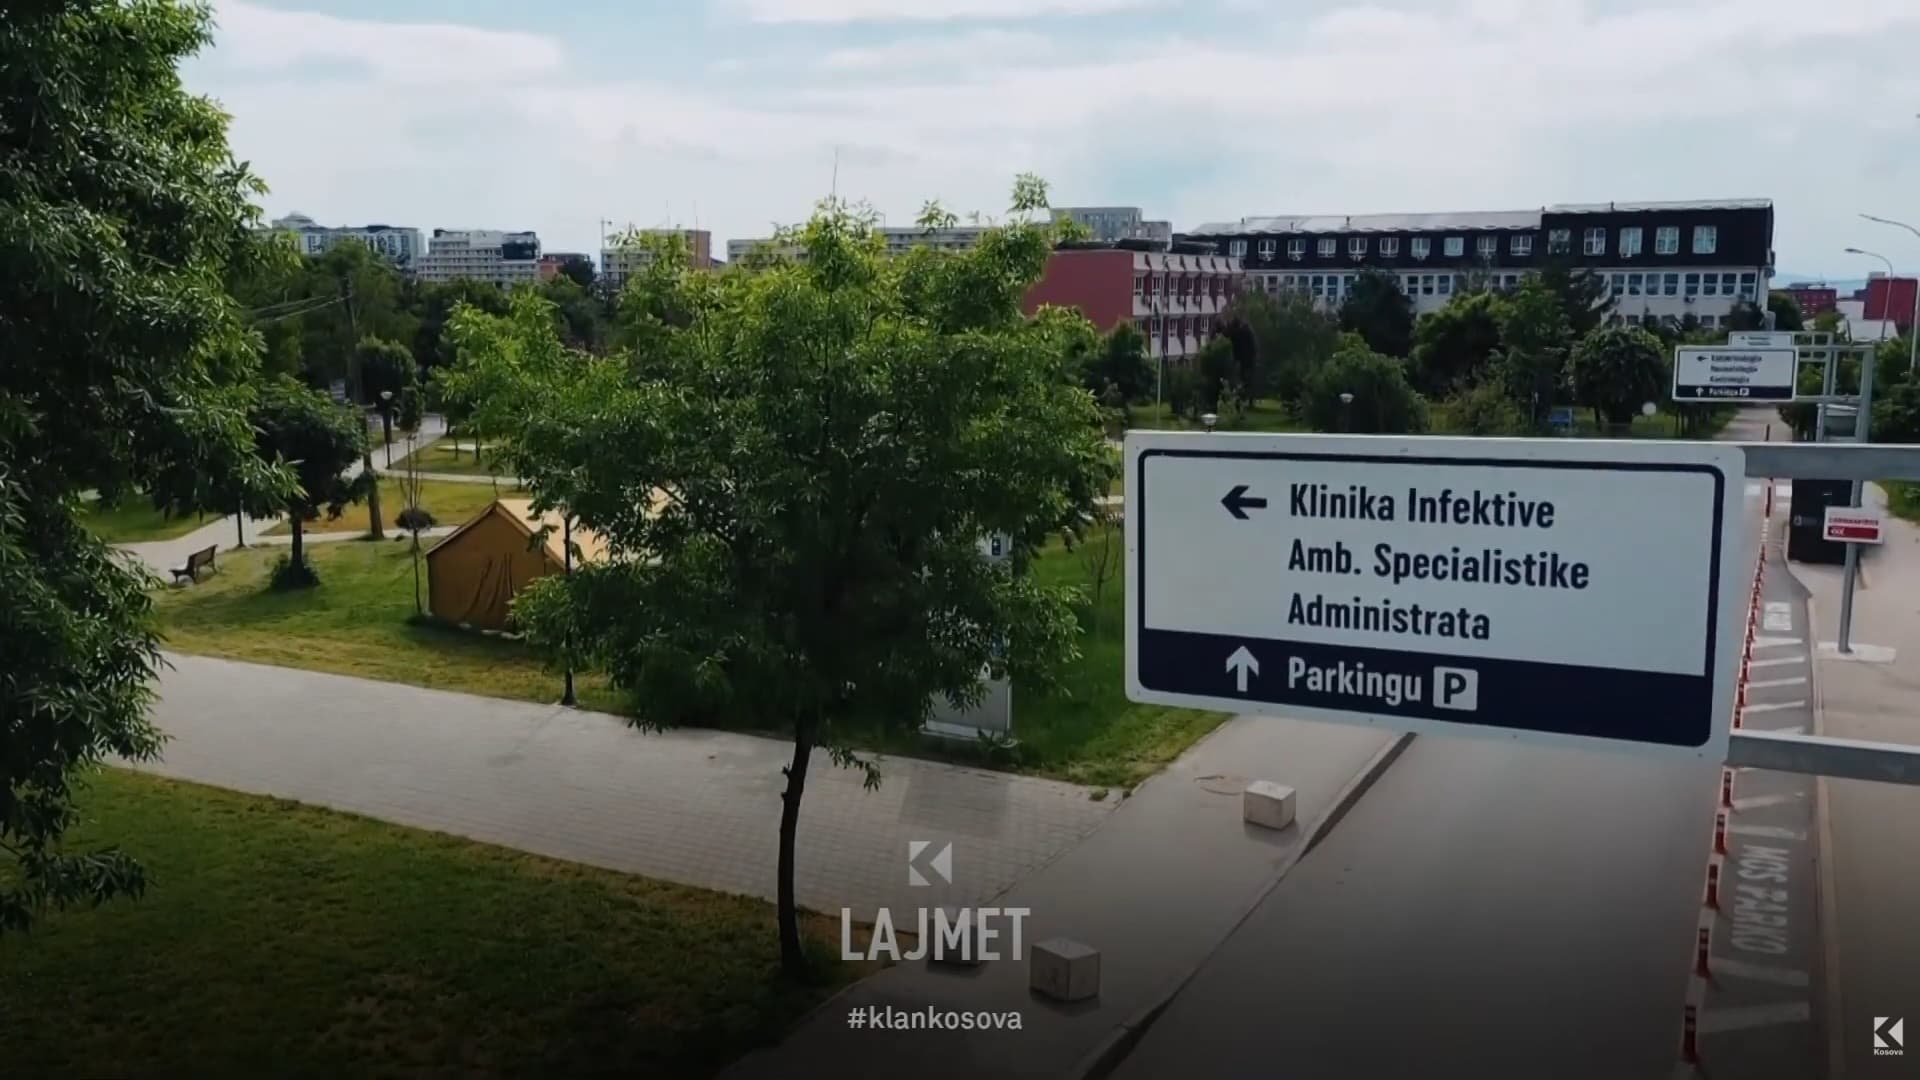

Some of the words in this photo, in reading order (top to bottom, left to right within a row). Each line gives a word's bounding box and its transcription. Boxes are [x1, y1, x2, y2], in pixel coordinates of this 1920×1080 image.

[1290, 483, 1395, 522] Klinika
[1408, 487, 1555, 529] Infektive
[1288, 538, 1362, 575] Amb.
[1373, 542, 1589, 590] Specialistike
[1287, 592, 1490, 641] Administrata
[1288, 656, 1422, 706] Parkingu
[1737, 844, 1790, 882] MOS
